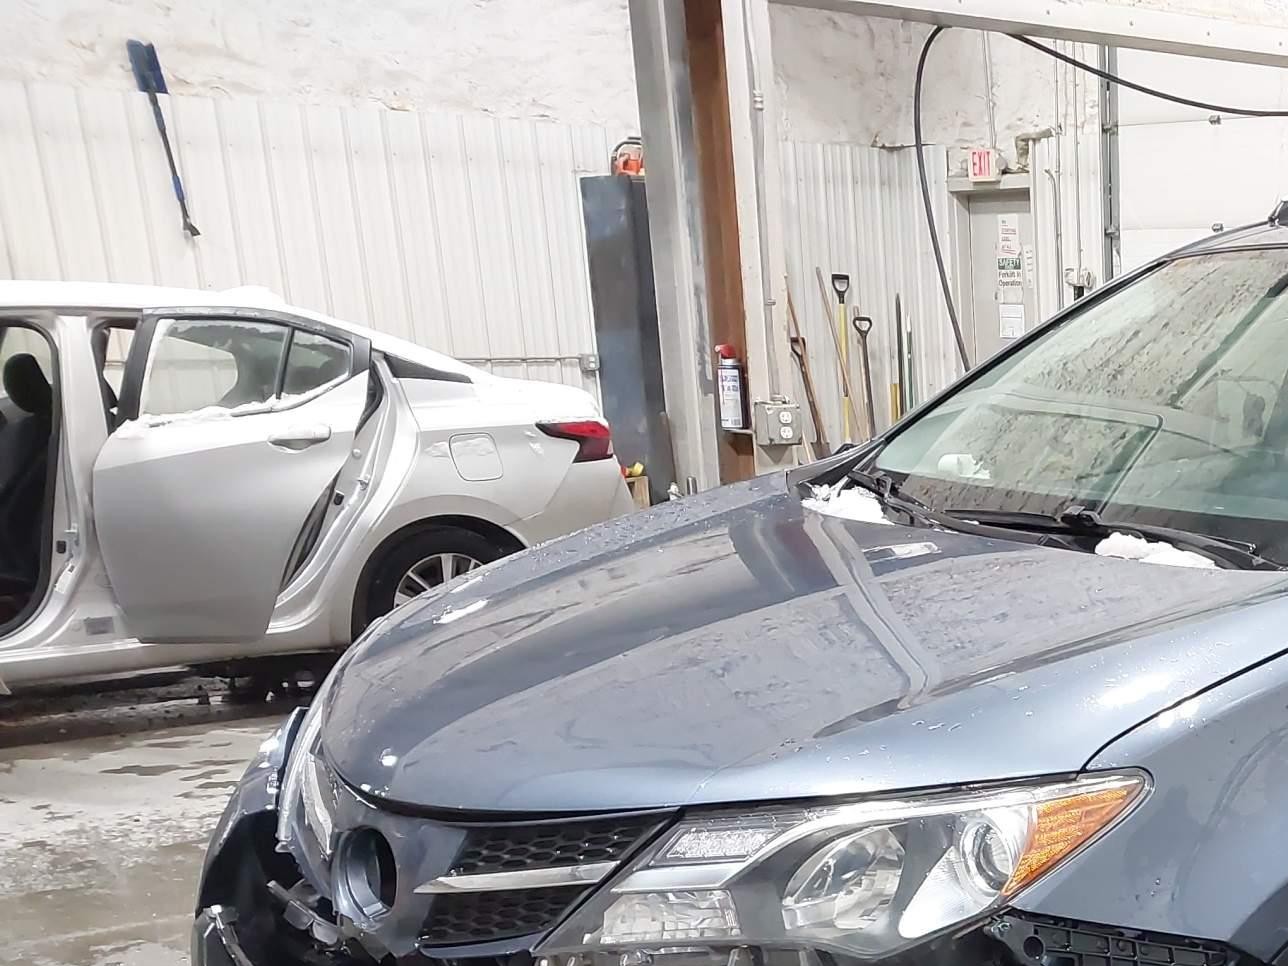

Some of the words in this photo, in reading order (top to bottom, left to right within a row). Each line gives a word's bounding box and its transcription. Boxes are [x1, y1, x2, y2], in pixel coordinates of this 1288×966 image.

[972, 151, 991, 177] EXIT
[998, 258, 1021, 266] SAFETY
[998, 279, 1022, 288] Operation
